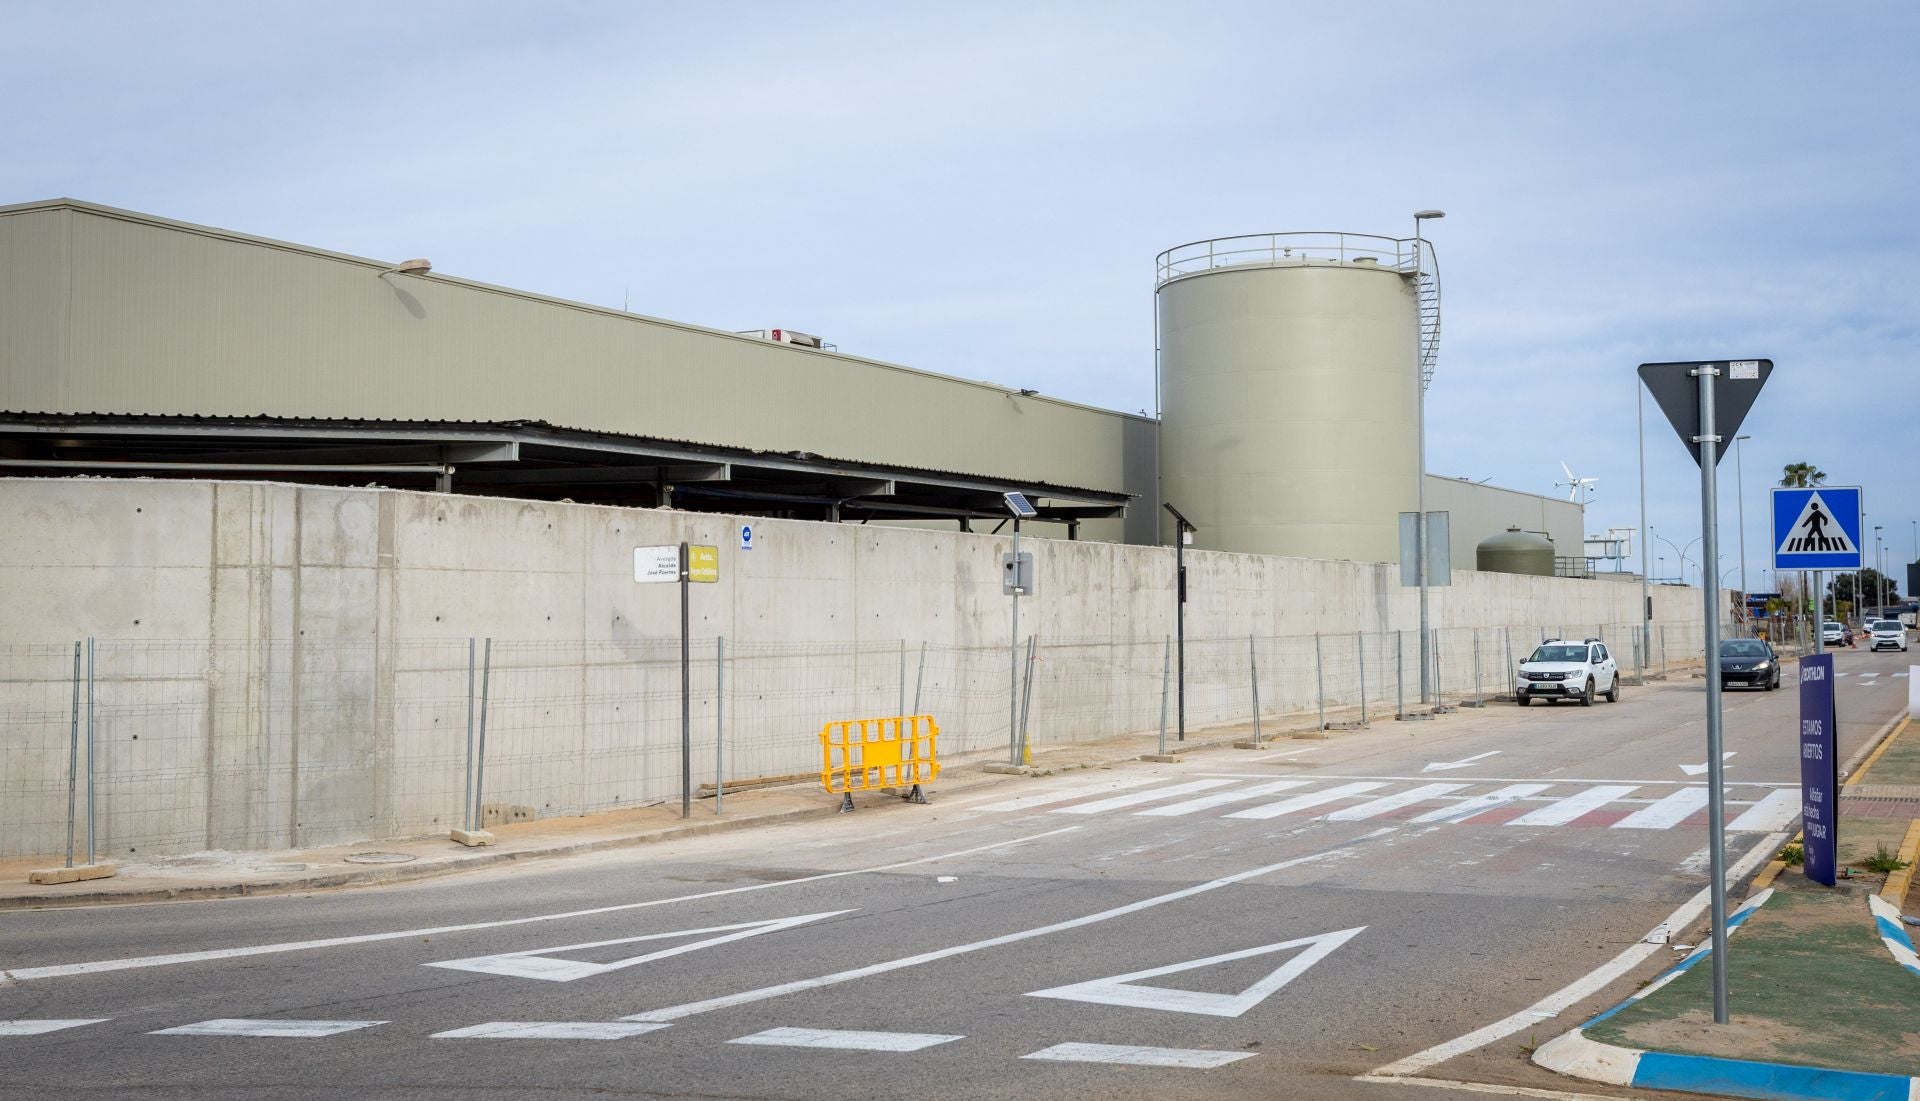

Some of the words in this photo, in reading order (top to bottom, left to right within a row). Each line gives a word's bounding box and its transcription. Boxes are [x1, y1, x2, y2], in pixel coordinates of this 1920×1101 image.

[1802, 665, 1825, 681] DECATHLON
[1802, 719, 1822, 735] ESTAMOS
[1802, 743, 1823, 760] ABIERTOS
[1811, 822, 1826, 840] JUGAR
